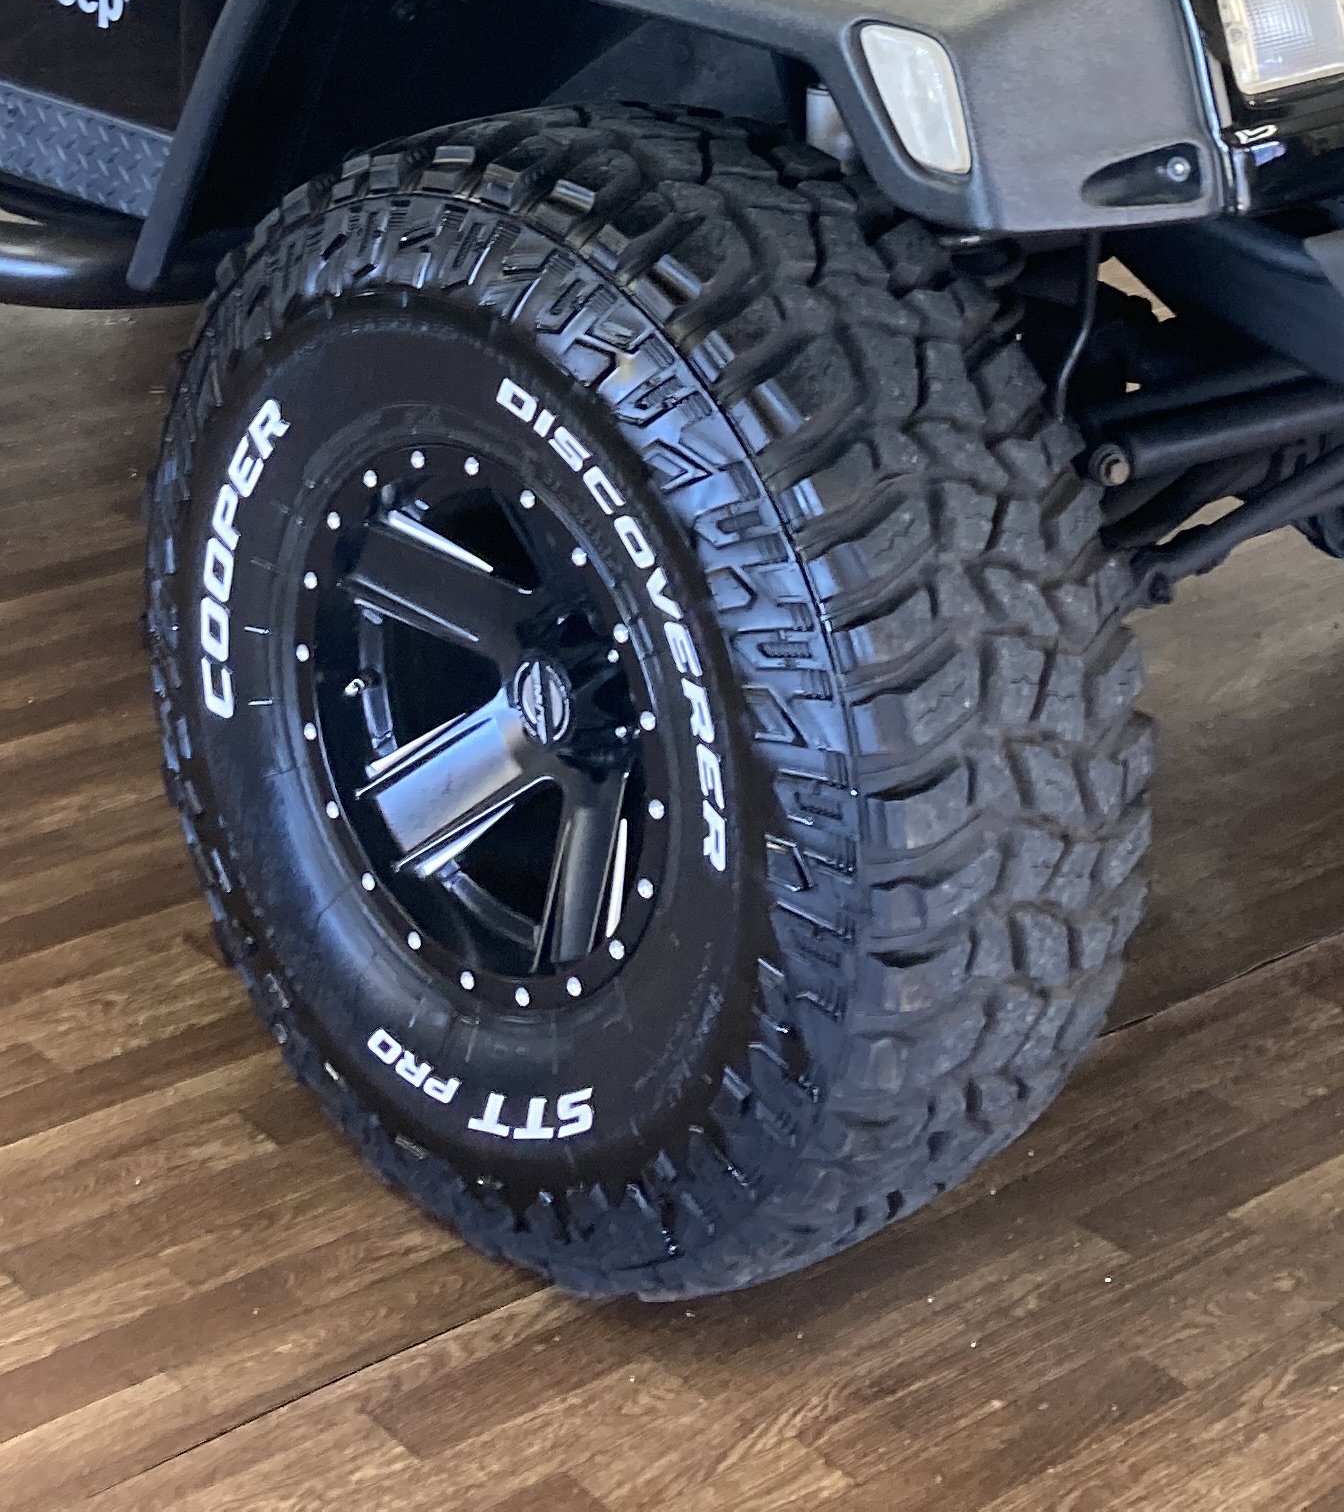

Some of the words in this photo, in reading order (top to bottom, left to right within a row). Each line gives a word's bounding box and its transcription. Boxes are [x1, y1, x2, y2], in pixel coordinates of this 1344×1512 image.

[200, 398, 292, 719] COOPER
[497, 377, 728, 873] DISCOVERER
[367, 1025, 464, 1105] PRO
[468, 1087, 594, 1141] STT
